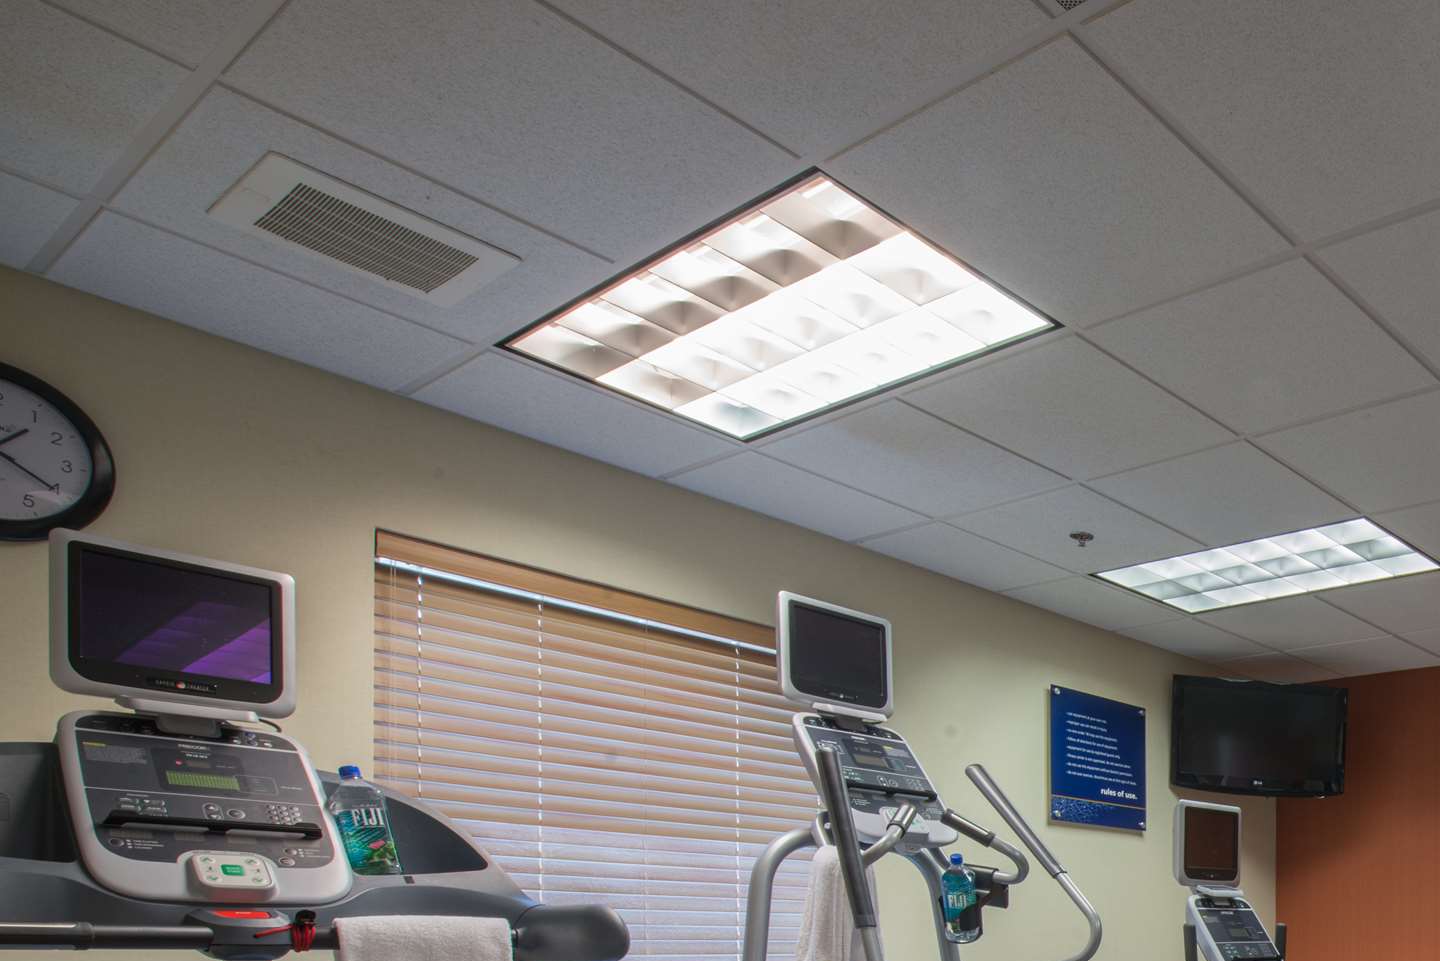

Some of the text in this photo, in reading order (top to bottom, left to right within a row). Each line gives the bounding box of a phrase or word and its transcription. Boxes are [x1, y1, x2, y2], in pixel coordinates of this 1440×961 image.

[50, 431, 63, 446] 2
[61, 459, 73, 473] 3
[22, 494, 35, 508] 5
[1100, 787, 1138, 800] rules of use.
[351, 807, 385, 827] FIJI
